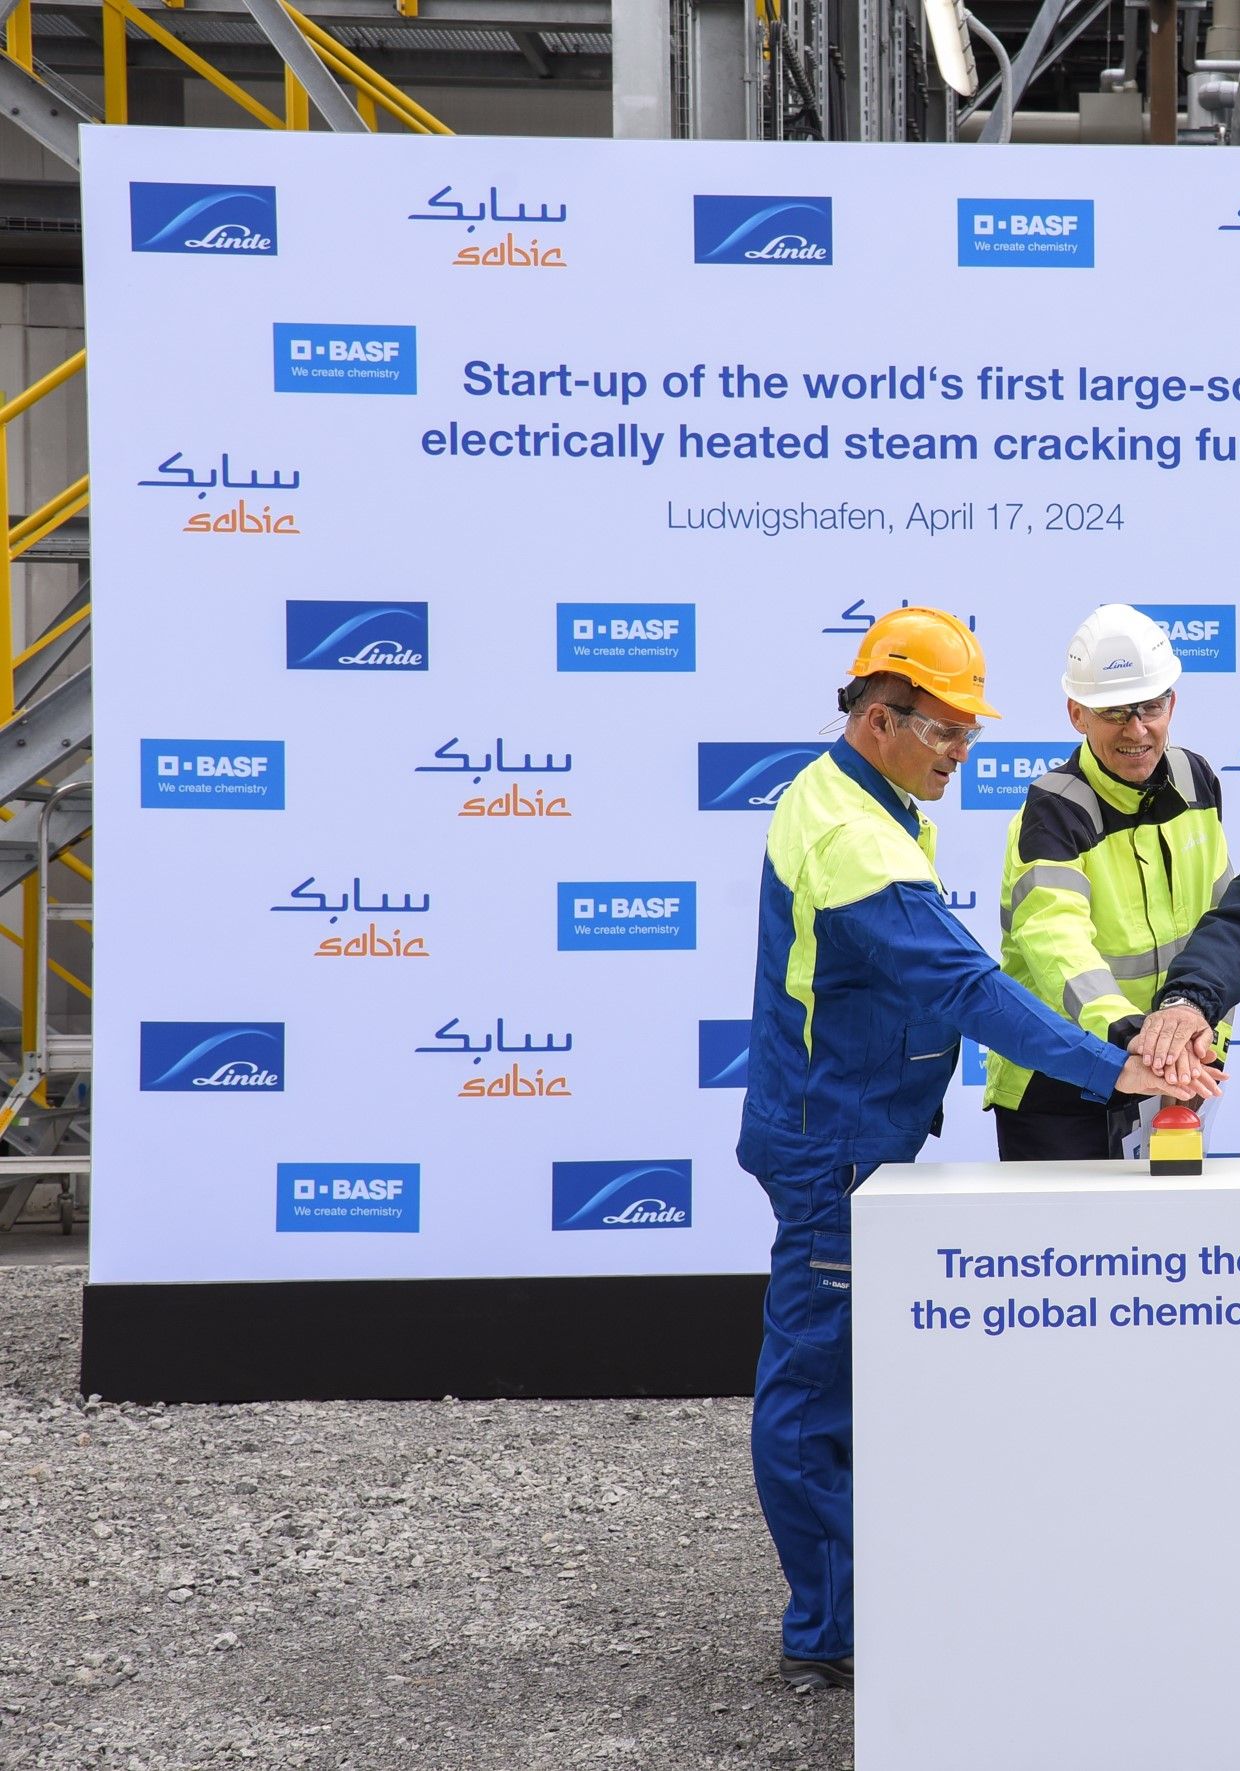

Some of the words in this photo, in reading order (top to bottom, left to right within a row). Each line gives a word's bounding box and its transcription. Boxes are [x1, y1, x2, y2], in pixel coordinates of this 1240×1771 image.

[1011, 215, 1077, 236] BASF
[185, 225, 270, 249] Linde
[744, 234, 827, 260] Linde
[974, 240, 991, 251] We
[993, 242, 1026, 252] create
[1027, 241, 1078, 254] chemistry
[453, 231, 567, 266] sabic
[330, 341, 399, 362] BASF
[290, 366, 309, 377] We
[311, 367, 345, 378] create
[346, 367, 400, 381] chemistry
[464, 361, 647, 405] Start-up
[663, 364, 705, 398] of
[719, 365, 788, 398] the
[977, 367, 1064, 400] first
[422, 422, 664, 465] electrically
[680, 424, 828, 459] heated
[845, 428, 977, 459] steam
[994, 427, 1180, 469] cracking
[183, 498, 300, 534] sabic
[669, 501, 893, 536] Ludwigshafen,
[906, 503, 972, 536] April
[988, 504, 1031, 534] 17,
[1046, 504, 1124, 530] 2024
[611, 620, 679, 640] BASF
[339, 641, 422, 665] Linde
[573, 645, 591, 656] We
[592, 646, 626, 656] create
[627, 646, 679, 658] chemistry
[1173, 647, 1220, 659] hemistry
[1102, 659, 1134, 671] Linde
[197, 757, 267, 777] BASF
[1013, 757, 1071, 779] BA
[157, 782, 176, 793] We
[178, 783, 212, 793] create
[214, 783, 268, 796] chemistry
[458, 782, 571, 816] sabic
[977, 783, 995, 795] We
[996, 784, 1029, 794] create
[612, 898, 679, 918] BASF
[314, 922, 429, 956] sabic
[574, 924, 592, 935] We
[593, 925, 626, 935] create
[628, 924, 680, 936] chemistry
[193, 1062, 277, 1085] Linde
[458, 1062, 571, 1097] sabic
[333, 1179, 403, 1200] BASF
[293, 1206, 312, 1216] We
[313, 1206, 348, 1216] create
[349, 1206, 403, 1219] chemistry
[602, 1198, 686, 1226] Linde
[937, 1247, 1186, 1282] Transforming
[911, 1300, 970, 1329] the
[984, 1297, 1096, 1336] global
